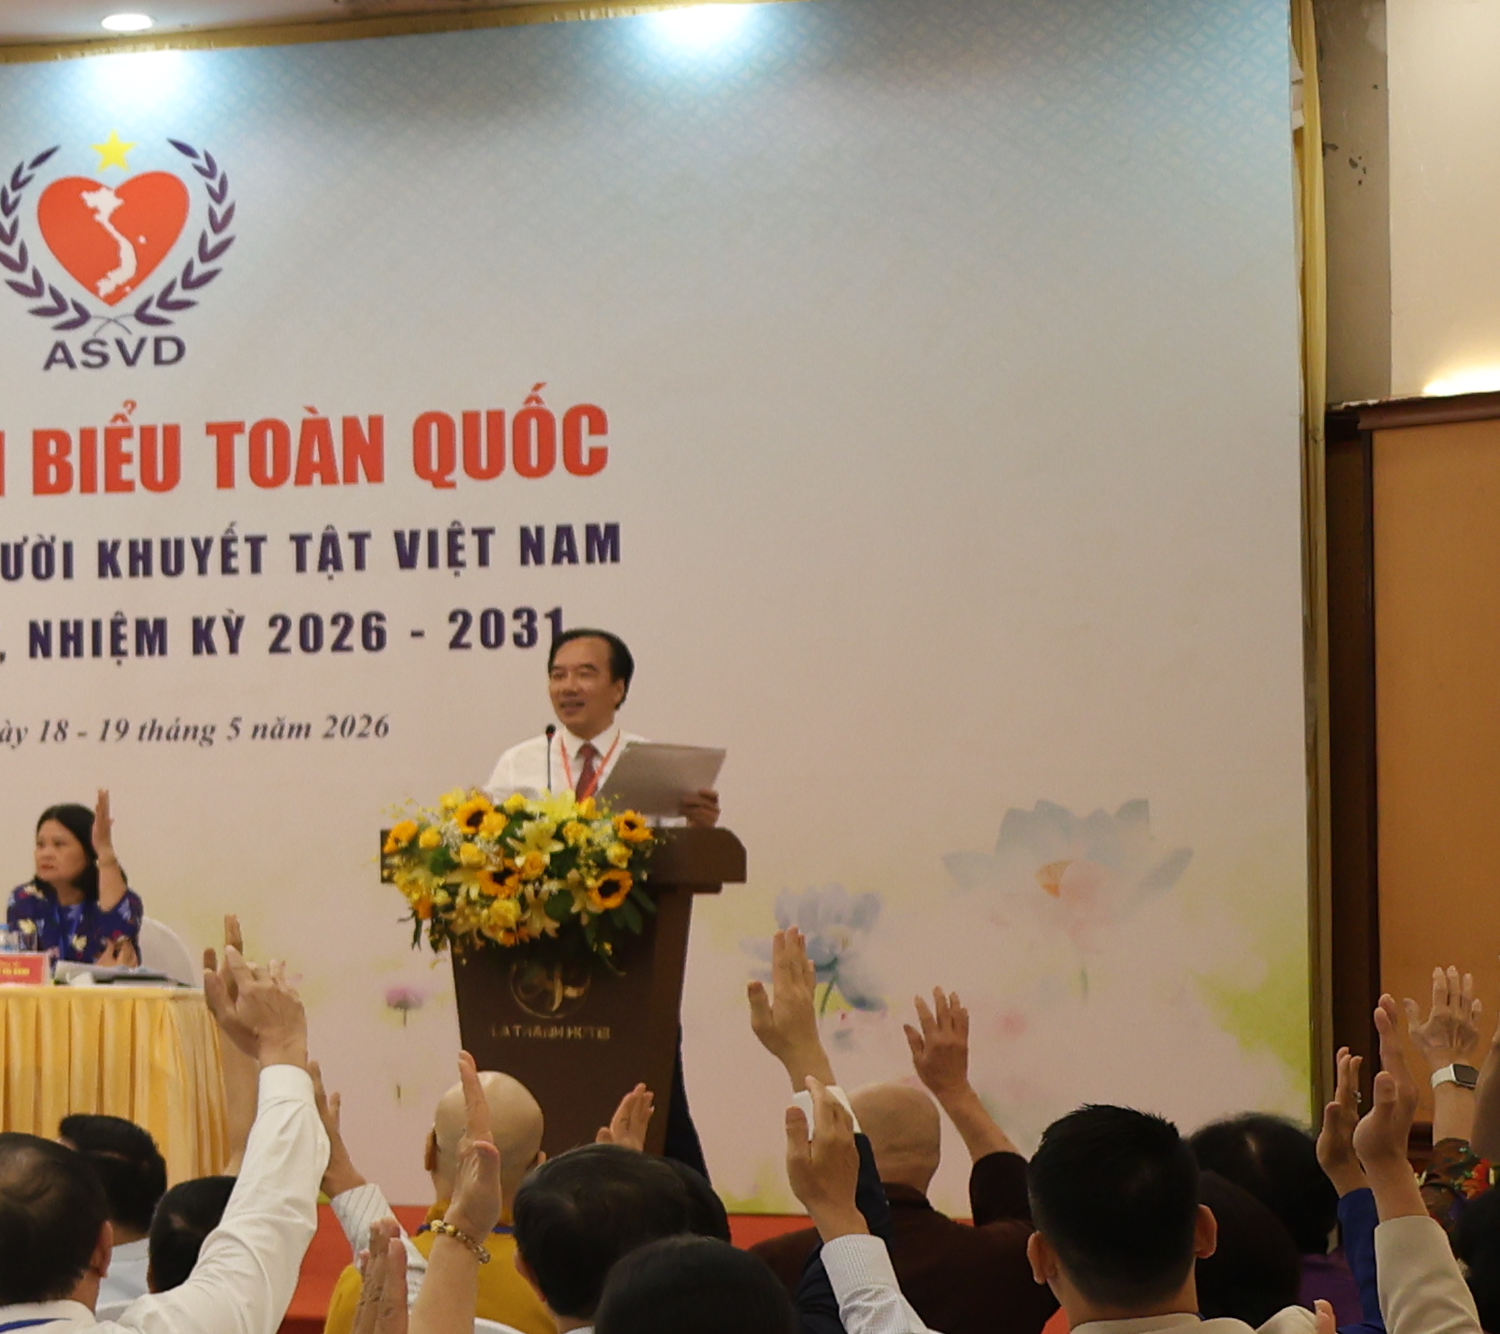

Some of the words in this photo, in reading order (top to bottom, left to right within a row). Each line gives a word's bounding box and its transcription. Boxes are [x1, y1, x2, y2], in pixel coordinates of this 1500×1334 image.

[42, 335, 187, 372] ASVD
[31, 398, 182, 497] BIỂU
[204, 405, 385, 491] TOÀN
[411, 381, 609, 491] QUỐC
[96, 521, 268, 580] KHUYẾT
[288, 523, 373, 582] TẬT
[392, 519, 496, 579] VIỆT
[519, 521, 621, 568] NAM
[28, 610, 168, 667] NHIỆM
[191, 608, 246, 657] KỲ
[267, 610, 387, 656] 2026
[409, 629, 426, 639] -
[447, 605, 564, 651] 2031
[39, 719, 69, 744] 18
[99, 718, 130, 743] 19
[137, 716, 217, 748] tháng
[226, 716, 243, 742] 5
[250, 716, 312, 741] năm
[321, 713, 390, 740] 2026
